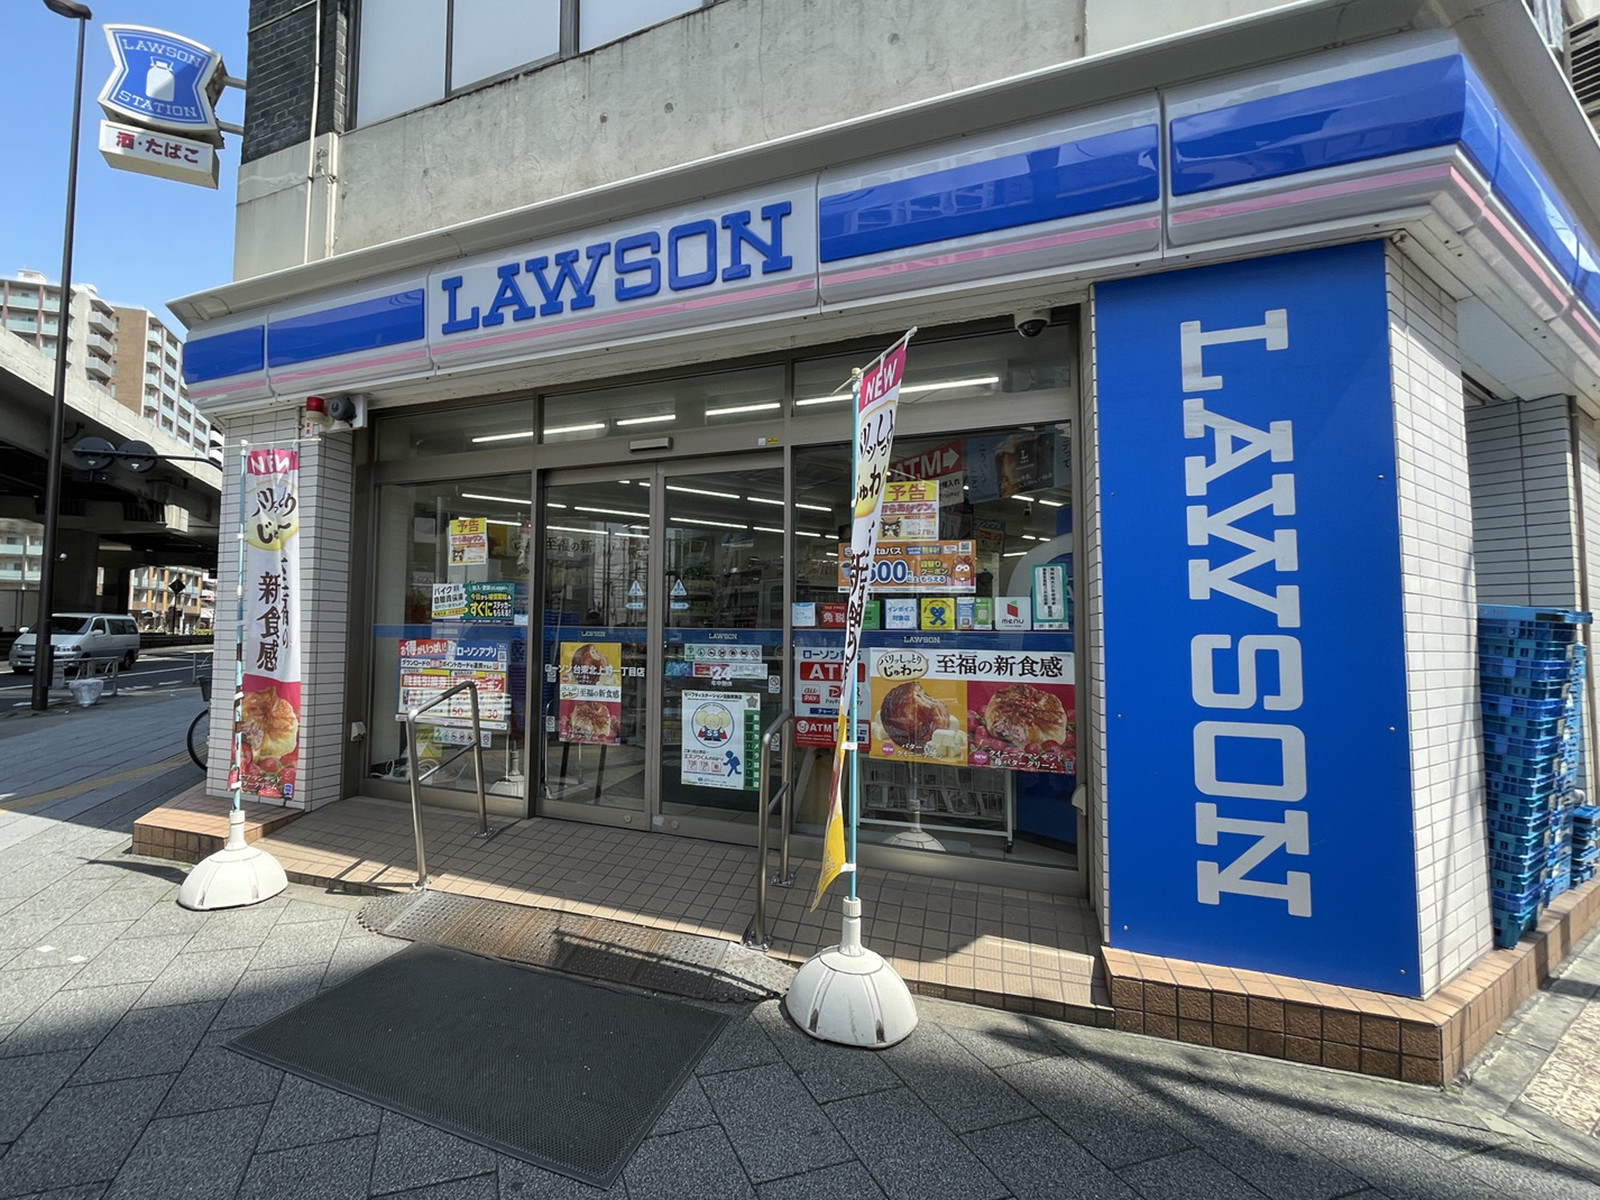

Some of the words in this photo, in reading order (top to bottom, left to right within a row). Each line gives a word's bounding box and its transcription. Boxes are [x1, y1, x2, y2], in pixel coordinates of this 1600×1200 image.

[122, 39, 202, 67] LAWSON
[118, 90, 198, 117] STATION
[116, 131, 199, 163] 酒・たばこ
[441, 200, 792, 335] LAWSON
[864, 358, 899, 405] NEW
[894, 450, 942, 482] ATM
[888, 484, 927, 502] 予告
[457, 519, 479, 533] 予告
[434, 586, 452, 596] バイク
[470, 601, 493, 617] すぐに
[823, 612, 845, 623] 免税
[1180, 308, 1312, 918] LAWSON
[256, 571, 281, 672] 新食感
[903, 636, 940, 644] LAWSON
[457, 646, 497, 658] ローソンアプリ
[879, 654, 922, 666] パリッしっとり
[711, 665, 731, 681] 24
[809, 663, 844, 681] AT
[935, 653, 1063, 678] 至福の新食感
[580, 689, 619, 699] 至福の新食感
[810, 721, 832, 732] ATM
